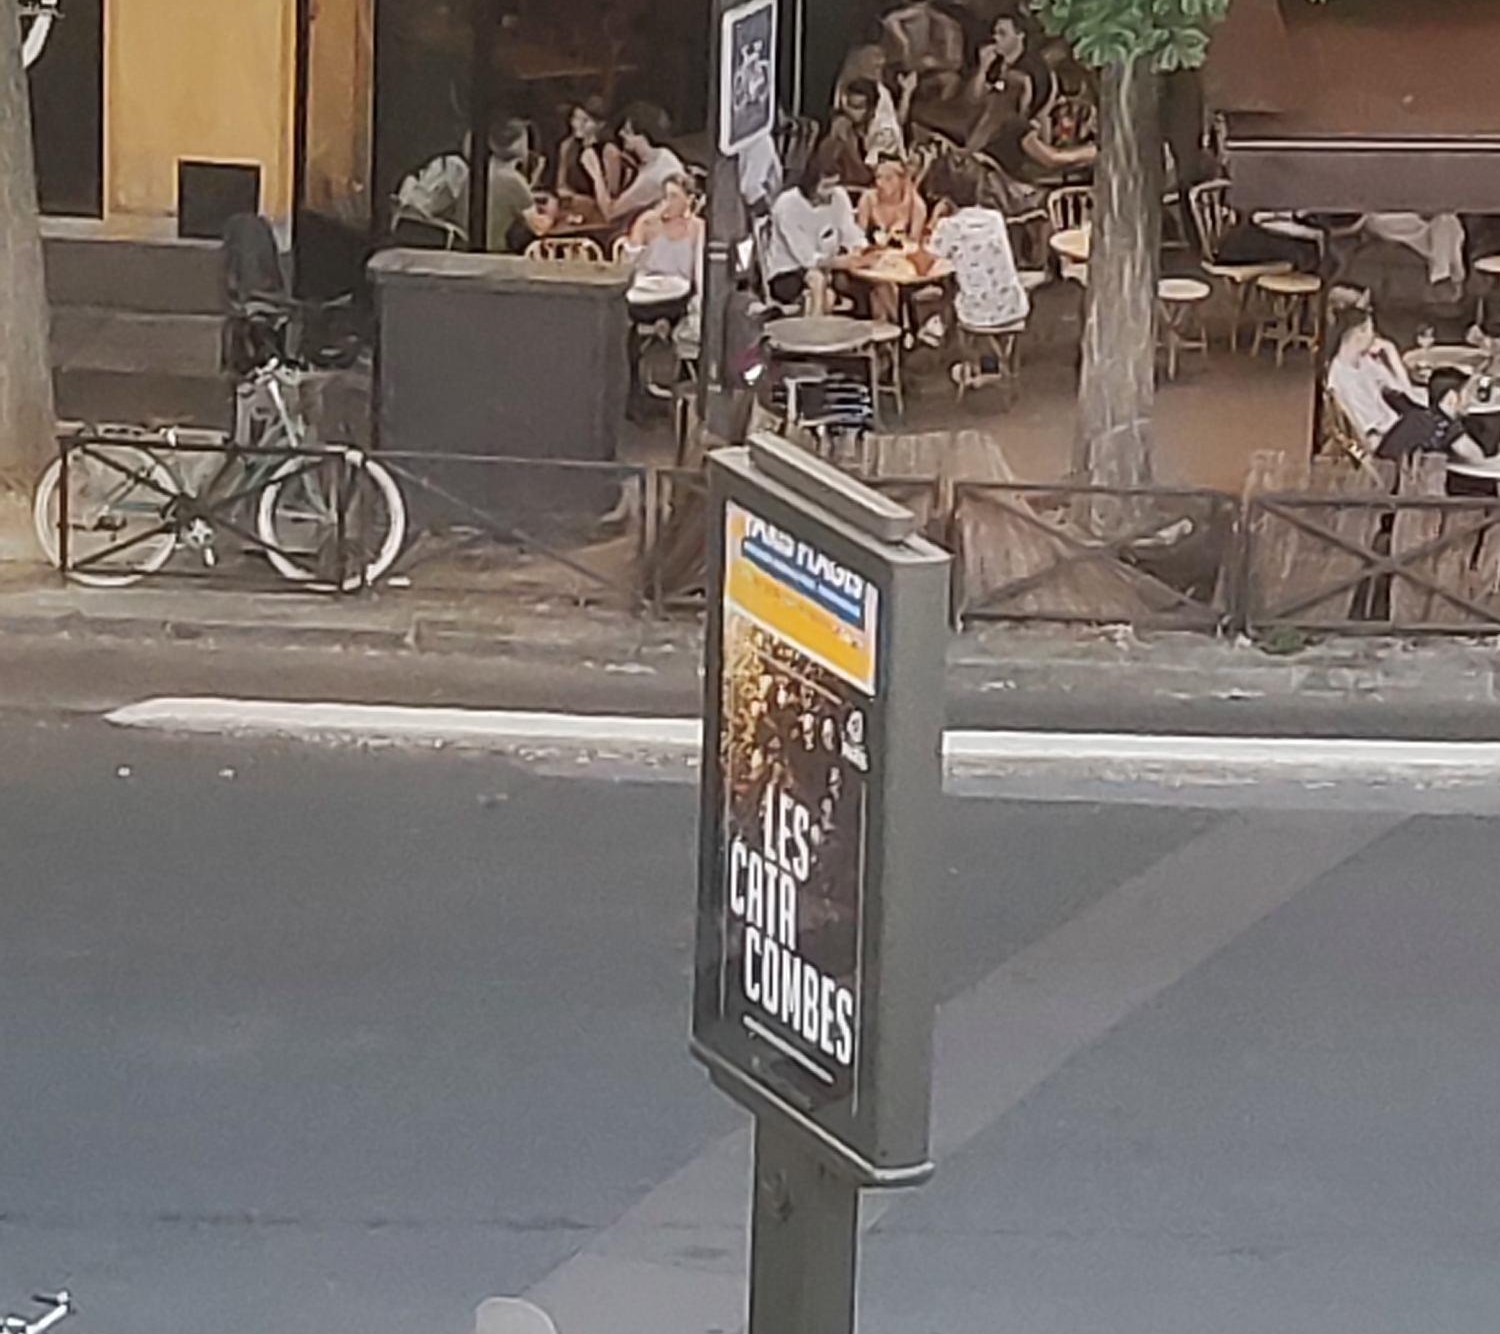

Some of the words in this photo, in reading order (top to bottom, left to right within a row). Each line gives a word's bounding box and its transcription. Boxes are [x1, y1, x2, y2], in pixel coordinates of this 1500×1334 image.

[763, 781, 810, 881] LES
[730, 839, 797, 951] CATA
[745, 925, 853, 1065] COMBES
